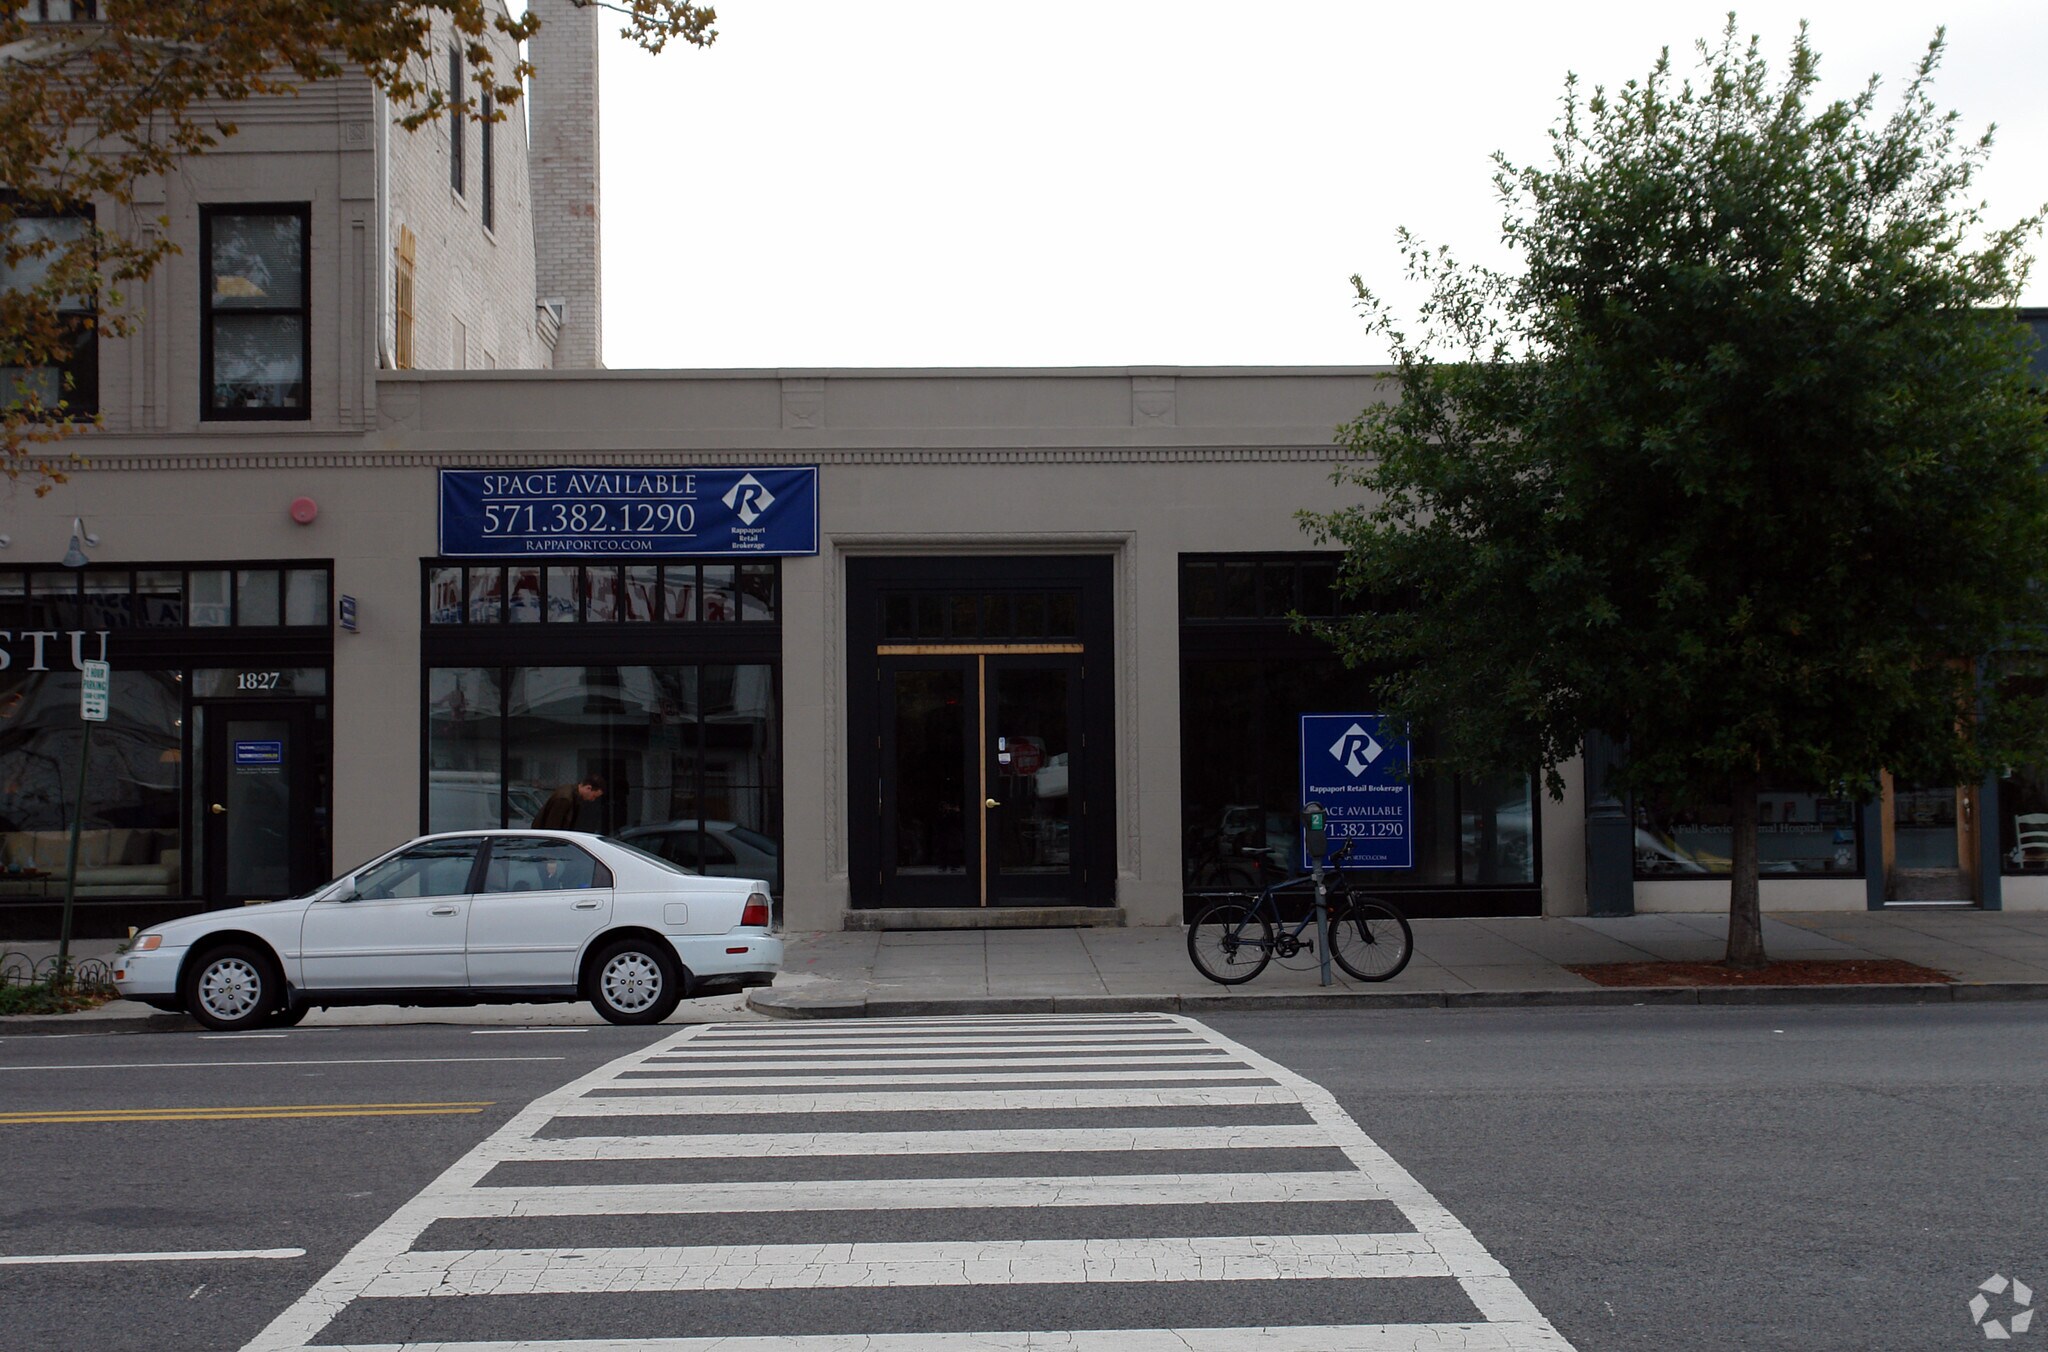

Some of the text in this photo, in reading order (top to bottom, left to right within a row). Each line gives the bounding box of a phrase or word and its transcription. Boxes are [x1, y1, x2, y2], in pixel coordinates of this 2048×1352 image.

[482, 474, 697, 495] SPACE AVAILABLE
[733, 484, 763, 514] R
[482, 503, 697, 533] 571.382.1290
[525, 539, 653, 551] RAPPAPORTCO.COM
[732, 542, 766, 550] Brokerage
[83, 680, 107, 690] PARKING
[237, 672, 281, 690] 1827
[1340, 734, 1371, 766] R
[1309, 785, 1345, 794] Rappaport
[1368, 785, 1404, 793] Brokerage
[1324, 806, 1403, 816] ACE AVAILABLE
[1312, 815, 1319, 824] 2
[1324, 823, 1403, 836] 1.382.1290
[1678, 824, 1698, 834] Full
[1700, 824, 1735, 834] Servic
[1780, 823, 1824, 835] Hospital
